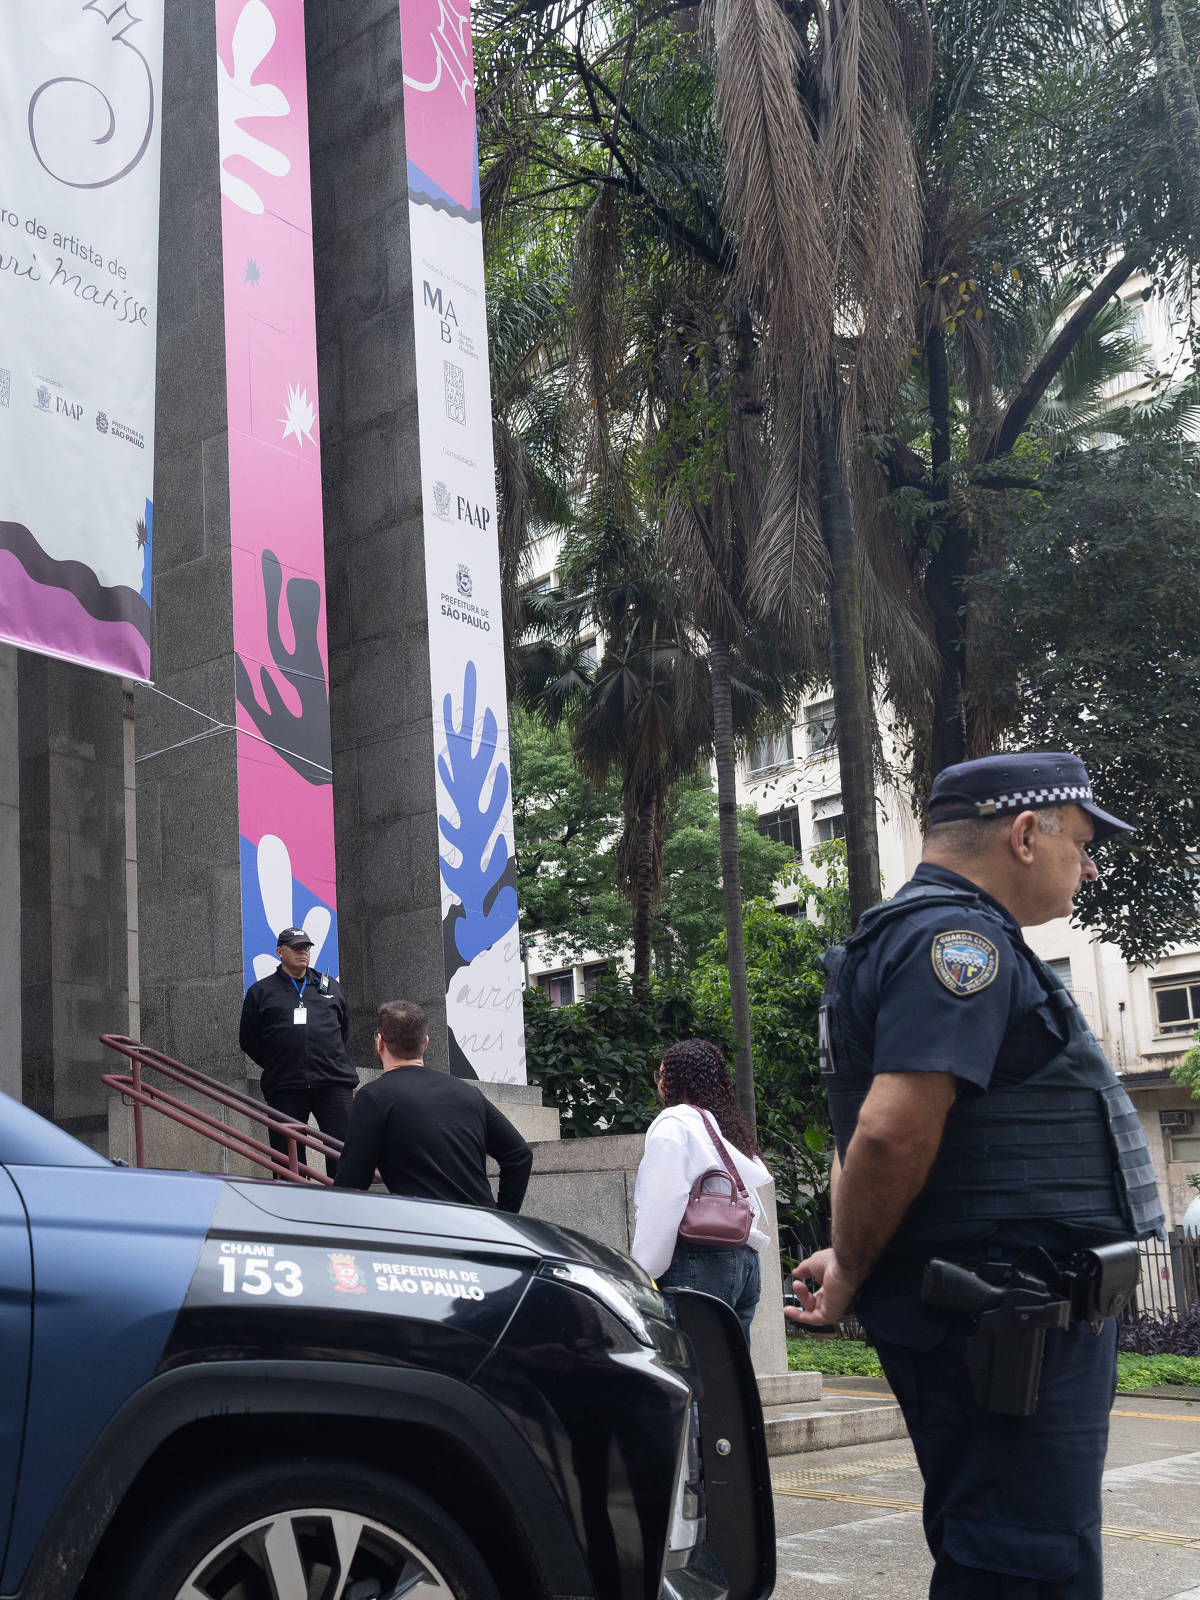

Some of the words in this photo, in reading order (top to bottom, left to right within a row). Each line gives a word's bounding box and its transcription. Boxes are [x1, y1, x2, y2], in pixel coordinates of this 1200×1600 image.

[25, 217, 48, 240] de
[52, 232, 103, 268] artista
[107, 259, 127, 280] de
[49, 257, 148, 326] Matisse
[56, 396, 84, 421] FAAP
[111, 427, 125, 440] SÃO
[125, 433, 145, 449] PAULO
[112, 420, 138, 438] PREFEITURA
[457, 495, 490, 531] FAAP
[441, 593, 480, 614] PREFEITURA
[480, 608, 490, 619] DE
[441, 604, 460, 621] SÃO
[461, 612, 491, 632] PAULO
[939, 933, 973, 944] GUARDA
[974, 937, 992, 952] CIVIL
[220, 1243, 275, 1258] CHAME
[218, 1256, 304, 1298] 153
[372, 1262, 458, 1282] PREFEITURA
[460, 1271, 481, 1283] DE
[375, 1275, 420, 1295] SÃO
[421, 1281, 485, 1302] PAULO
